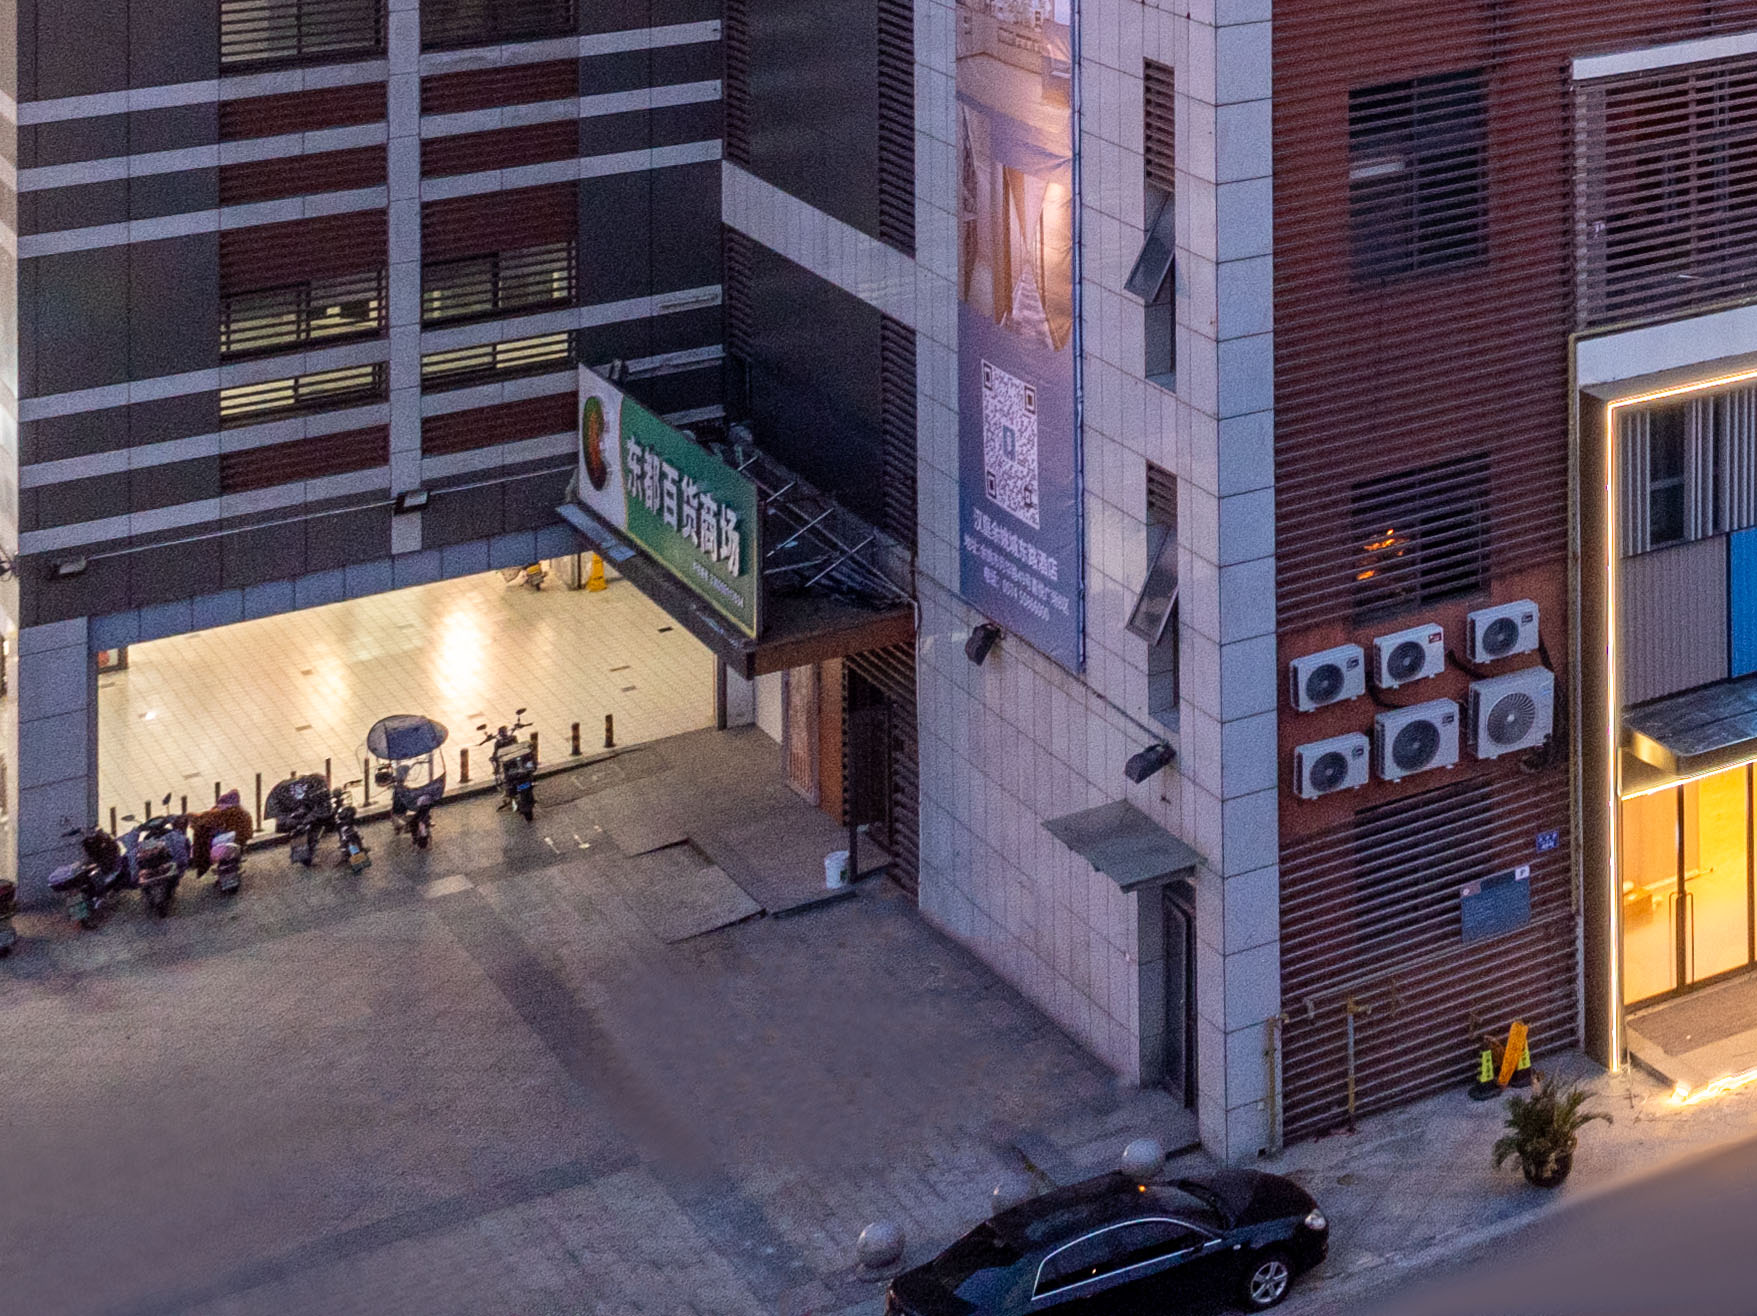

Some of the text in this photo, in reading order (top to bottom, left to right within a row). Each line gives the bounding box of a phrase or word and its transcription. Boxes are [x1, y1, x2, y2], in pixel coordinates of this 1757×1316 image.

[625, 435, 741, 578] 东都百货商场
